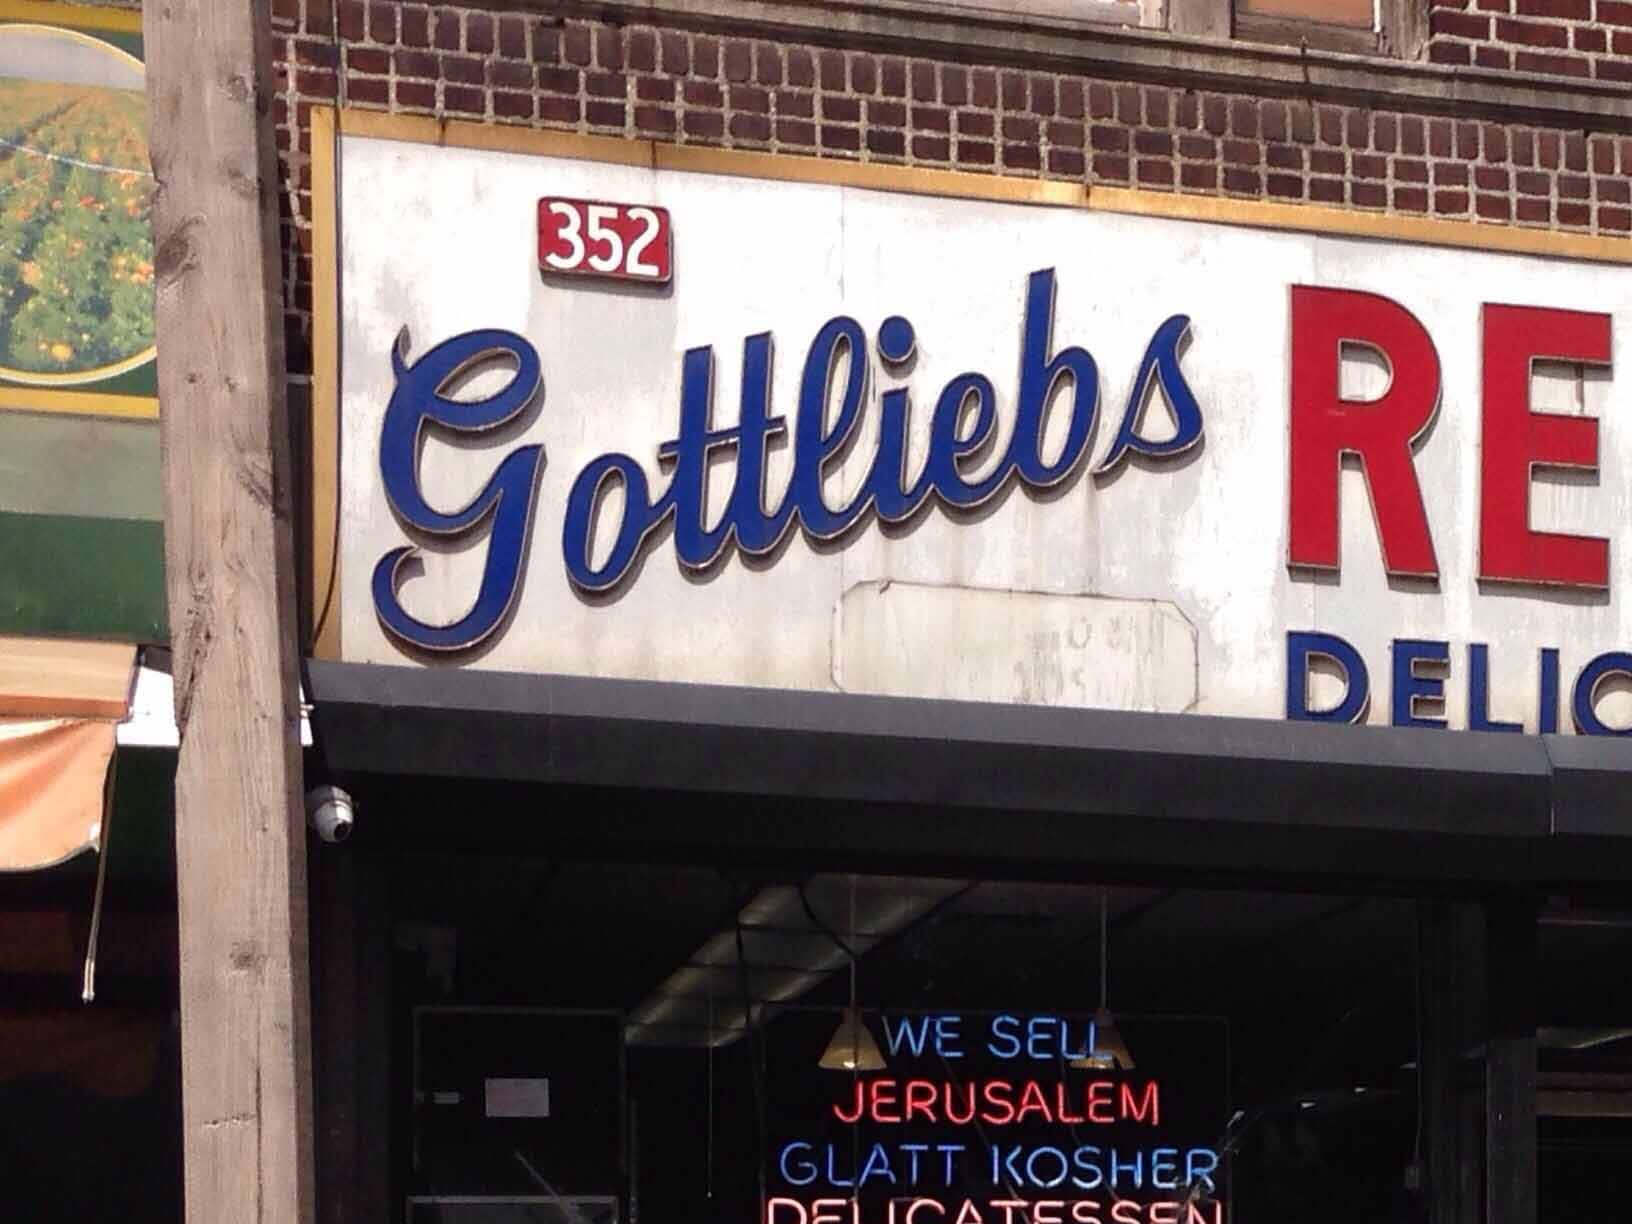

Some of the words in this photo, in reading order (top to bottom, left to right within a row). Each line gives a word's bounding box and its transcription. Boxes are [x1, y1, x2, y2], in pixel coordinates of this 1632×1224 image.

[546, 202, 661, 279] 352
[372, 266, 1204, 652] Gottliebs
[881, 1014, 964, 1058] WE
[987, 1015, 1112, 1060] SELL
[832, 1080, 1160, 1126] JERUSALEM
[779, 1142, 966, 1187] GLATT
[992, 1144, 1219, 1192] KOSHER
